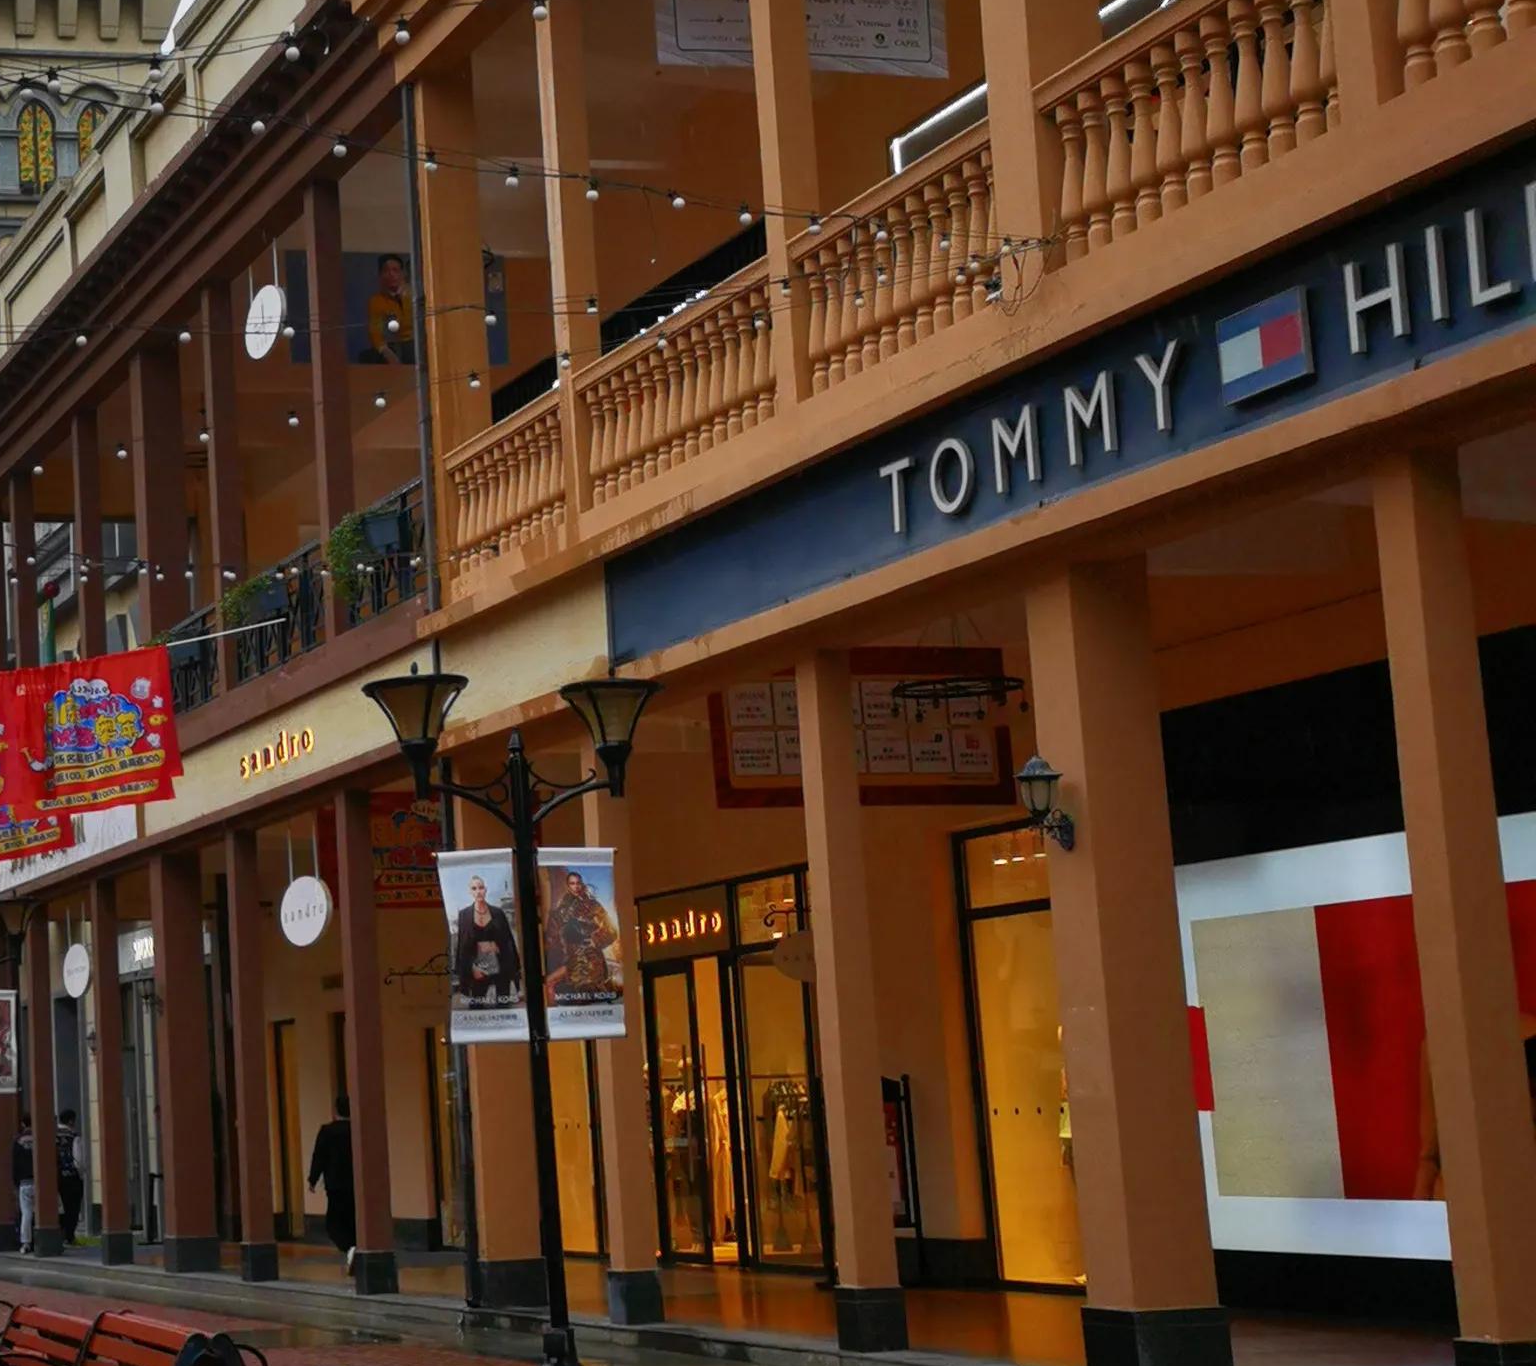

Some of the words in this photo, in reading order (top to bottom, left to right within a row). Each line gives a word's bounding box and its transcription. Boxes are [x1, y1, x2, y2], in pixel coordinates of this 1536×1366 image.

[879, 338, 1182, 533] TOMMY
[1343, 181, 1536, 356] HIL
[240, 727, 314, 779] sandro
[646, 909, 722, 944] sandro
